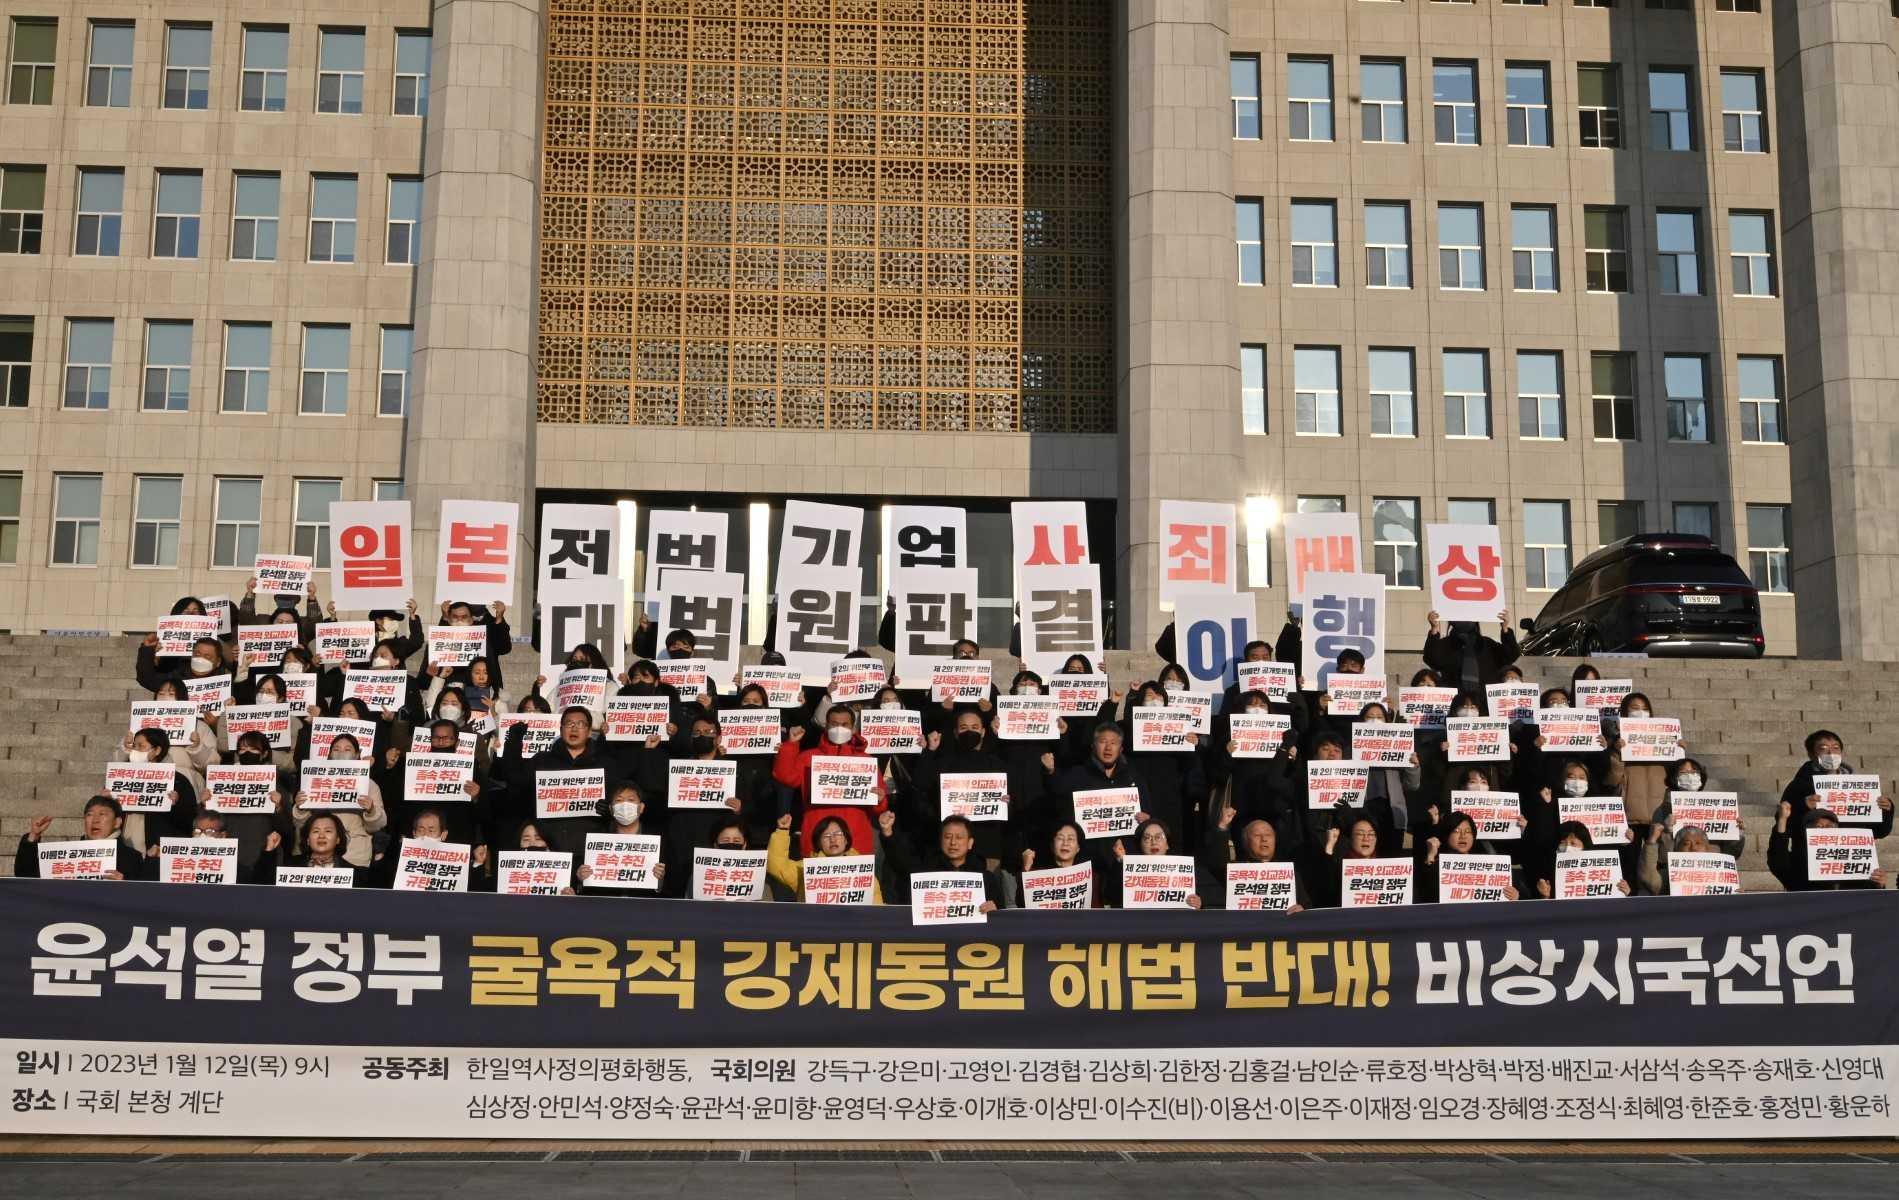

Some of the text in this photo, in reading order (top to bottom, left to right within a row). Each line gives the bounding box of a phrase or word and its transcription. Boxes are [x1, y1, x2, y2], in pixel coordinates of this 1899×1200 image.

[340, 525, 402, 588] 일
[446, 522, 508, 582] 본
[1168, 525, 1226, 584] 죄
[1438, 544, 1500, 600] 상
[550, 604, 615, 665] 대
[671, 595, 731, 662] 법
[788, 588, 849, 654] 원
[905, 592, 972, 656] 판
[1031, 589, 1096, 652] 결
[30, 923, 1855, 1011] 윤석열 정부 굴욕적 강제동원 해법 반대! 비상시국선언
[16, 1050, 328, 1078] 일시 2023년 1월 12일(목) 9시
[362, 1057, 449, 1081] 공동주최
[467, 1058, 693, 1084] 한일역사정의평화행동,
[711, 1059, 796, 1083] 국회의원
[12, 1088, 223, 1115] 장소 국회 본청 계단
